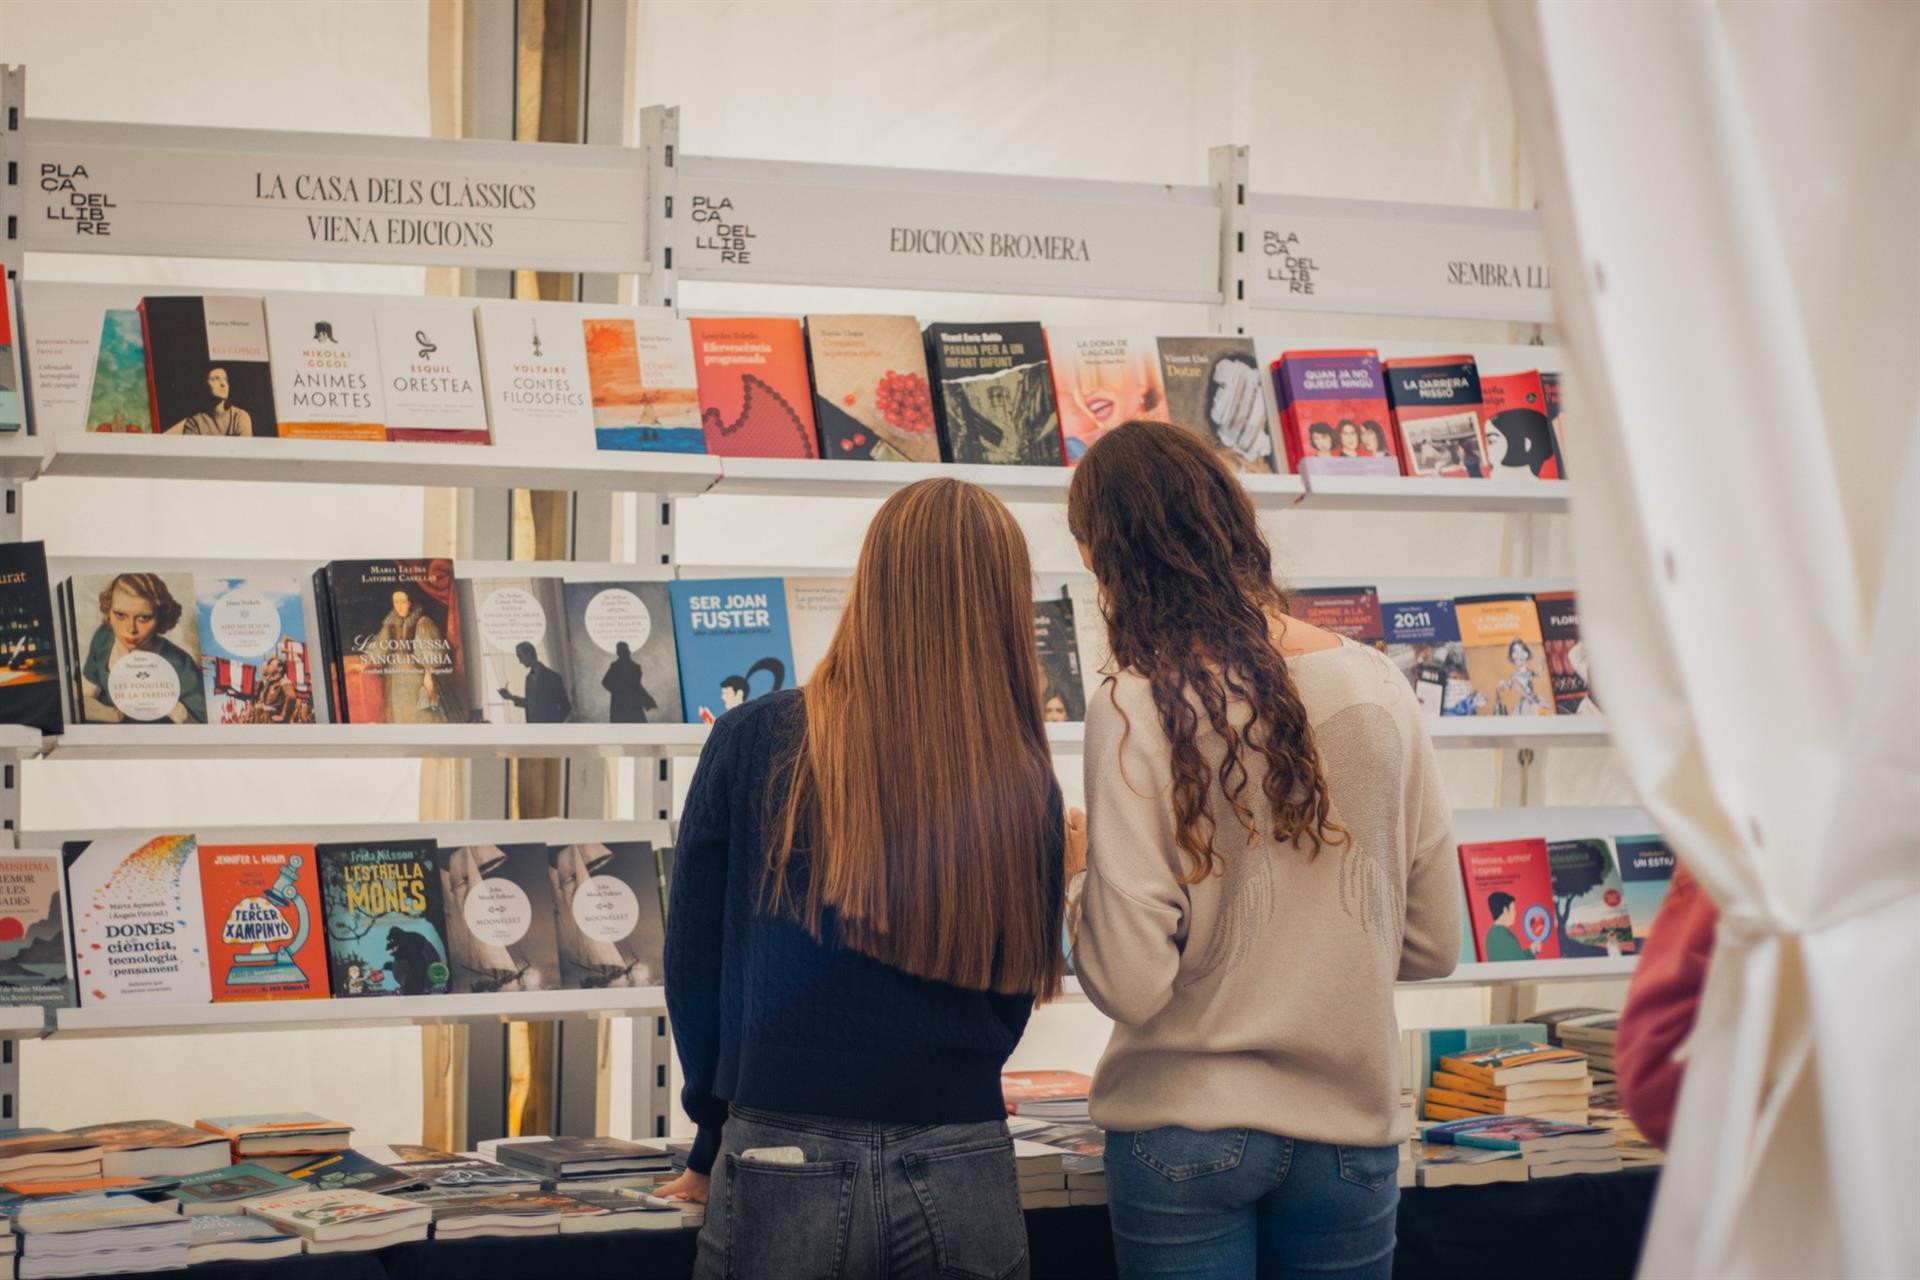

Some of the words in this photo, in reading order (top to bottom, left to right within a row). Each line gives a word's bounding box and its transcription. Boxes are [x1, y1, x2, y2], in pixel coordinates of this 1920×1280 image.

[41, 163, 89, 178] PLA
[255, 173, 286, 199] LA
[296, 174, 360, 203] CASA
[368, 177, 423, 205] DELS
[70, 193, 117, 208] DEL
[692, 196, 734, 210] PLA
[47, 206, 105, 221] LLIB
[76, 222, 111, 236] RE
[306, 215, 380, 243] VIENA
[387, 218, 494, 248] EDICIONS
[716, 224, 757, 238] DEL
[696, 237, 745, 251] LLIB
[1263, 231, 1299, 244] PLA
[890, 228, 985, 257] EDICIONS
[989, 233, 1091, 262] BROMERA
[721, 251, 751, 264] RE
[1285, 257, 1319, 271] DEL
[1267, 269, 1310, 282] LLIB
[1447, 262, 1521, 288] SEMBRA
[1289, 282, 1315, 295] RE
[980, 344, 999, 355] PER
[1001, 344, 1010, 354] A
[1011, 343, 1024, 355] UN
[1077, 340, 1089, 348] LA
[1091, 339, 1117, 348] DONA
[1119, 339, 1128, 347] DE
[308, 359, 349, 368] GOGOL
[945, 357, 977, 368] INFANT
[980, 356, 1013, 368] DIFUNT
[411, 364, 451, 374] ESQUIL
[513, 364, 567, 374] VOLTAIRE
[1167, 364, 1201, 377] Dotze
[1305, 369, 1336, 380] QUAN
[1338, 369, 1350, 380] JA
[1351, 368, 1368, 379] NO
[393, 376, 473, 393] ORESTEA
[513, 378, 570, 391] CONTES
[1304, 379, 1339, 390] QUEDE
[1403, 380, 1417, 390] LA
[1418, 377, 1470, 389] DARRERA
[293, 392, 372, 409] MORTES
[689, 596, 721, 611] SER
[724, 594, 768, 609] JOAN
[691, 610, 770, 629] FUSTER
[1394, 612, 1431, 628] 20:11
[379, 639, 450, 650] COMTESSA
[351, 850, 376, 862] Frida
[376, 850, 414, 863] Nilsson
[1506, 852, 1532, 864] amor
[1633, 857, 1647, 868] UN
[0, 862, 50, 873] MISHIMA
[344, 862, 424, 882] L'ESTRELLA
[7, 886, 26, 894] LES
[346, 880, 427, 914] MONES
[235, 909, 279, 921] TERCER
[105, 922, 176, 938] DONES
[114, 964, 179, 978] pensament
